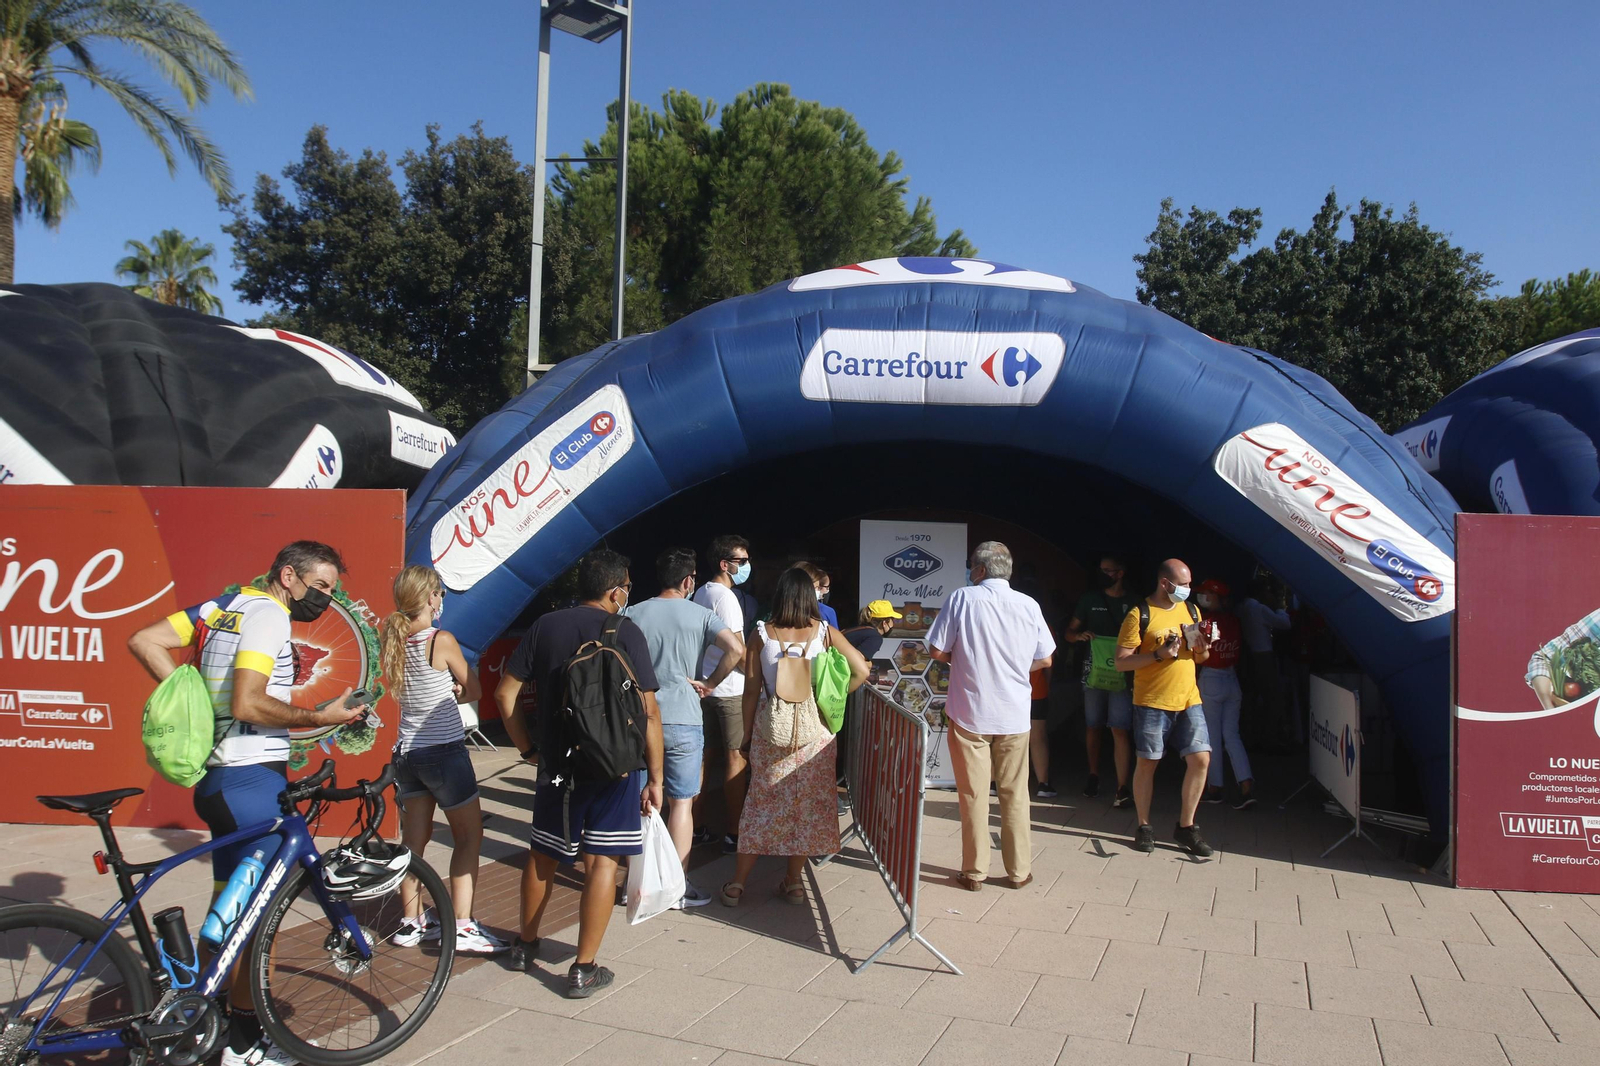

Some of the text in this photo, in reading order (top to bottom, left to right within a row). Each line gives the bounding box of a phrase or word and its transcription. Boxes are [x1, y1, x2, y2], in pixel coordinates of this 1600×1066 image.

[822, 350, 968, 380] Carrefour
[555, 431, 593, 465] El Club
[1301, 450, 1330, 476] NOS
[1241, 432, 1373, 543] une
[461, 489, 486, 513] NOS
[432, 460, 553, 565] une
[522, 509, 540, 527] VUELTA
[910, 534, 932, 542] 1970
[1297, 519, 1318, 538] VUELTA
[894, 557, 934, 572] Doray
[1373, 545, 1415, 580] El Club
[882, 582, 944, 599] Pura Miel
[10, 625, 105, 662] VUELTA
[26, 708, 79, 720] Carrefour
[1549, 757, 1568, 769] LO
[1529, 772, 1597, 783] Comprometidos
[1521, 783, 1573, 793] productores
[1509, 817, 1580, 836] LA VUELTA
[280, 897, 290, 912] DT
[204, 858, 287, 996] LAPIERRE
[268, 910, 281, 934] SWISS
